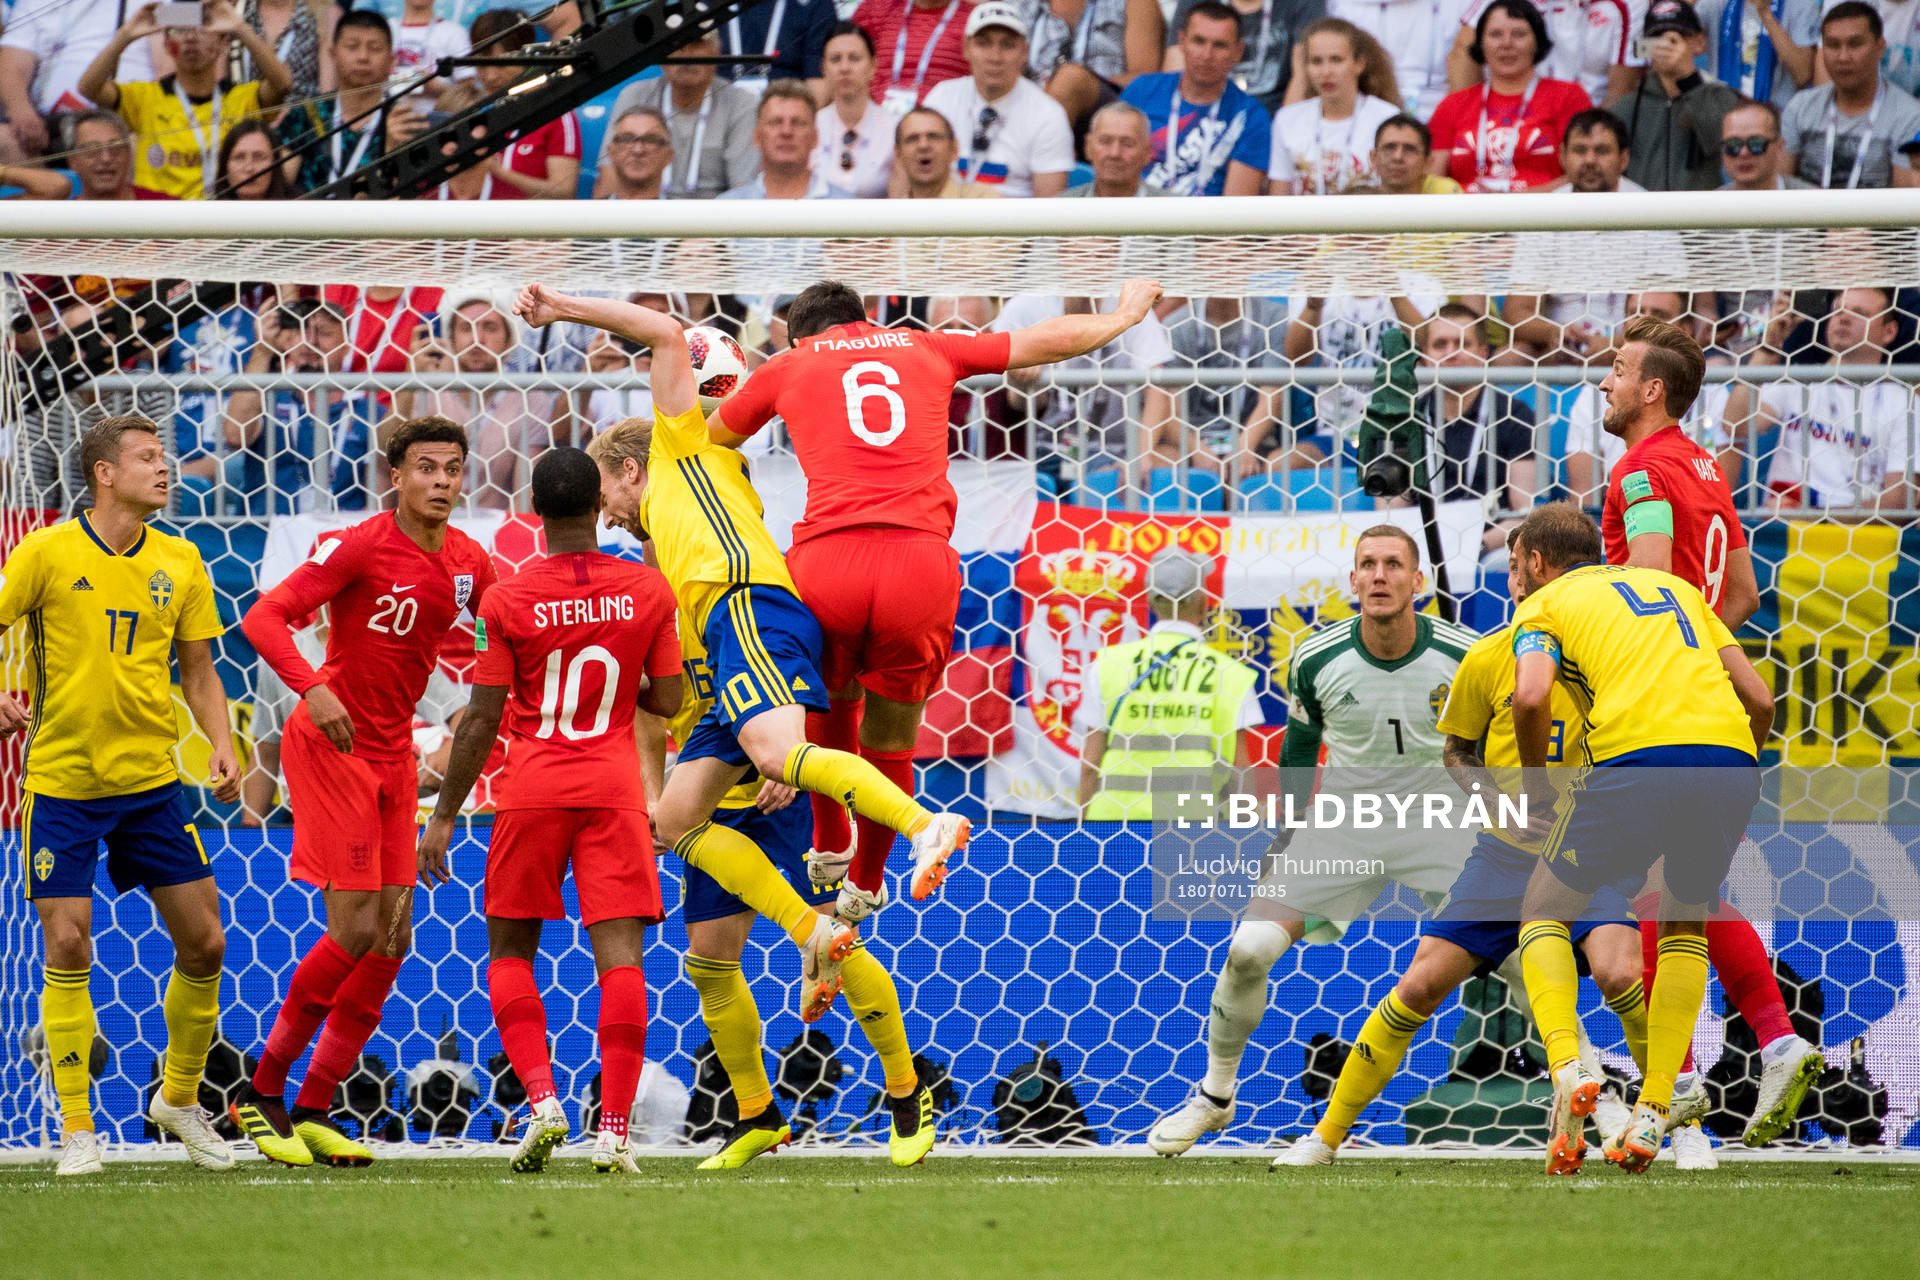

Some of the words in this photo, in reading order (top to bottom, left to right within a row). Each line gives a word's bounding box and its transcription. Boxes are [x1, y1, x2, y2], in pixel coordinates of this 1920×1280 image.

[814, 332, 914, 352] MAGUIRE
[842, 361, 906, 447] 6
[1691, 458, 1720, 481] KANE
[1701, 514, 1728, 609] 9
[105, 609, 139, 655] 17
[367, 594, 419, 637] 20
[533, 594, 635, 628] STERLING
[1611, 581, 1700, 650] 4
[534, 645, 621, 741] 10
[682, 657, 714, 700] 16
[721, 671, 763, 723] 10
[1129, 703, 1213, 720] STEWARD
[1388, 718, 1405, 755] 1
[183, 823, 209, 866] 1
